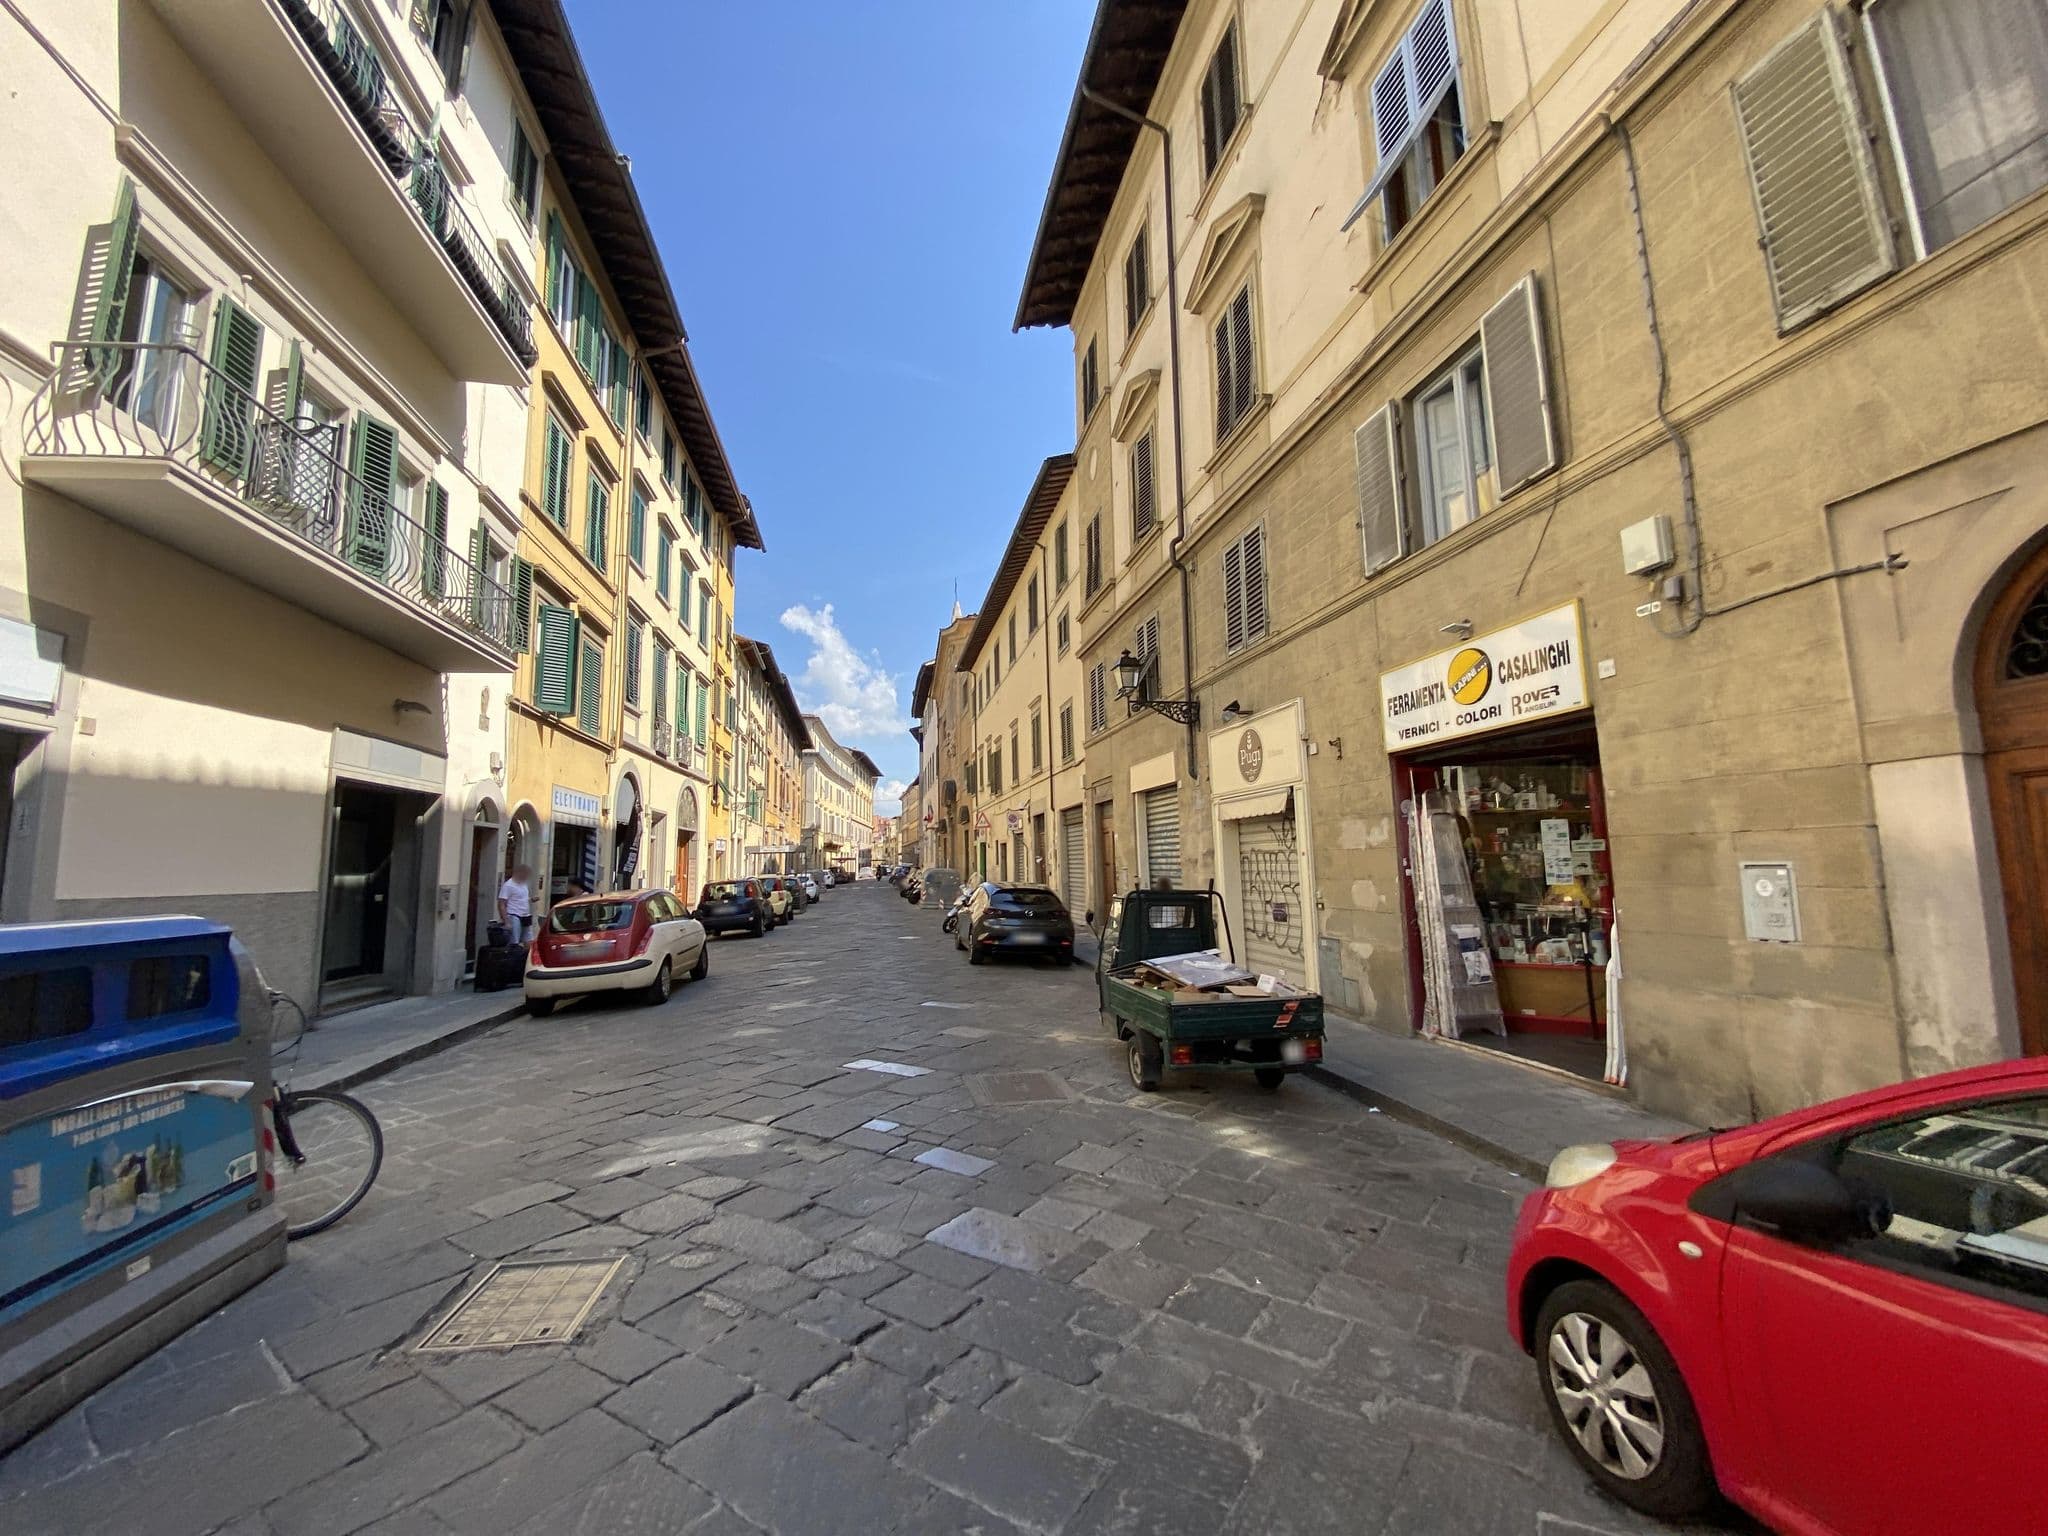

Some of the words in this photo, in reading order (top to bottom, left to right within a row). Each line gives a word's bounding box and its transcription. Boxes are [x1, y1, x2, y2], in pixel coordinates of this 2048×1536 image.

[1387, 681, 1447, 717] FERRAMENTA
[1498, 639, 1571, 685] CASALINGHI
[1398, 720, 1440, 740] VERNICI
[1455, 704, 1502, 726] COLORI
[1239, 749, 1261, 767] Pugi
